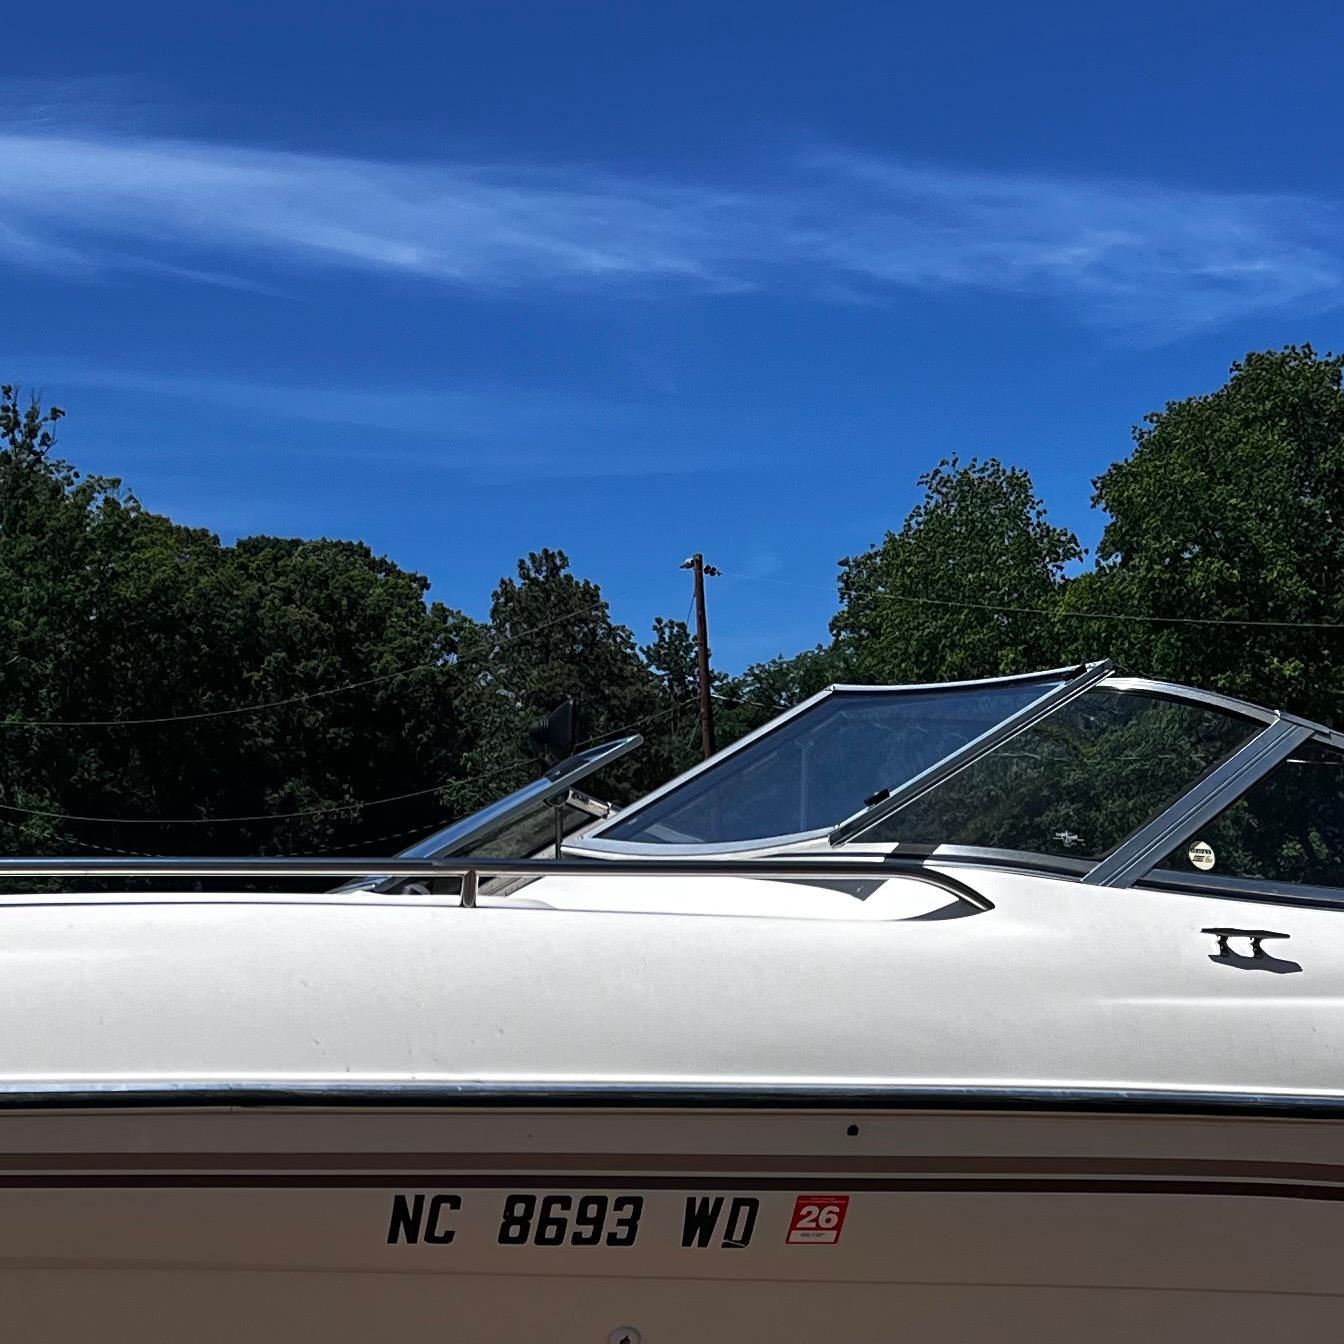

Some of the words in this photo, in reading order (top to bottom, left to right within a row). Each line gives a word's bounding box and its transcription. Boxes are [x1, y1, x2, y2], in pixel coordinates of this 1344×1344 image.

[387, 1195, 460, 1244] NC
[497, 1195, 644, 1246] 8693
[681, 1196, 760, 1248] WD
[796, 1205, 840, 1229] 26
